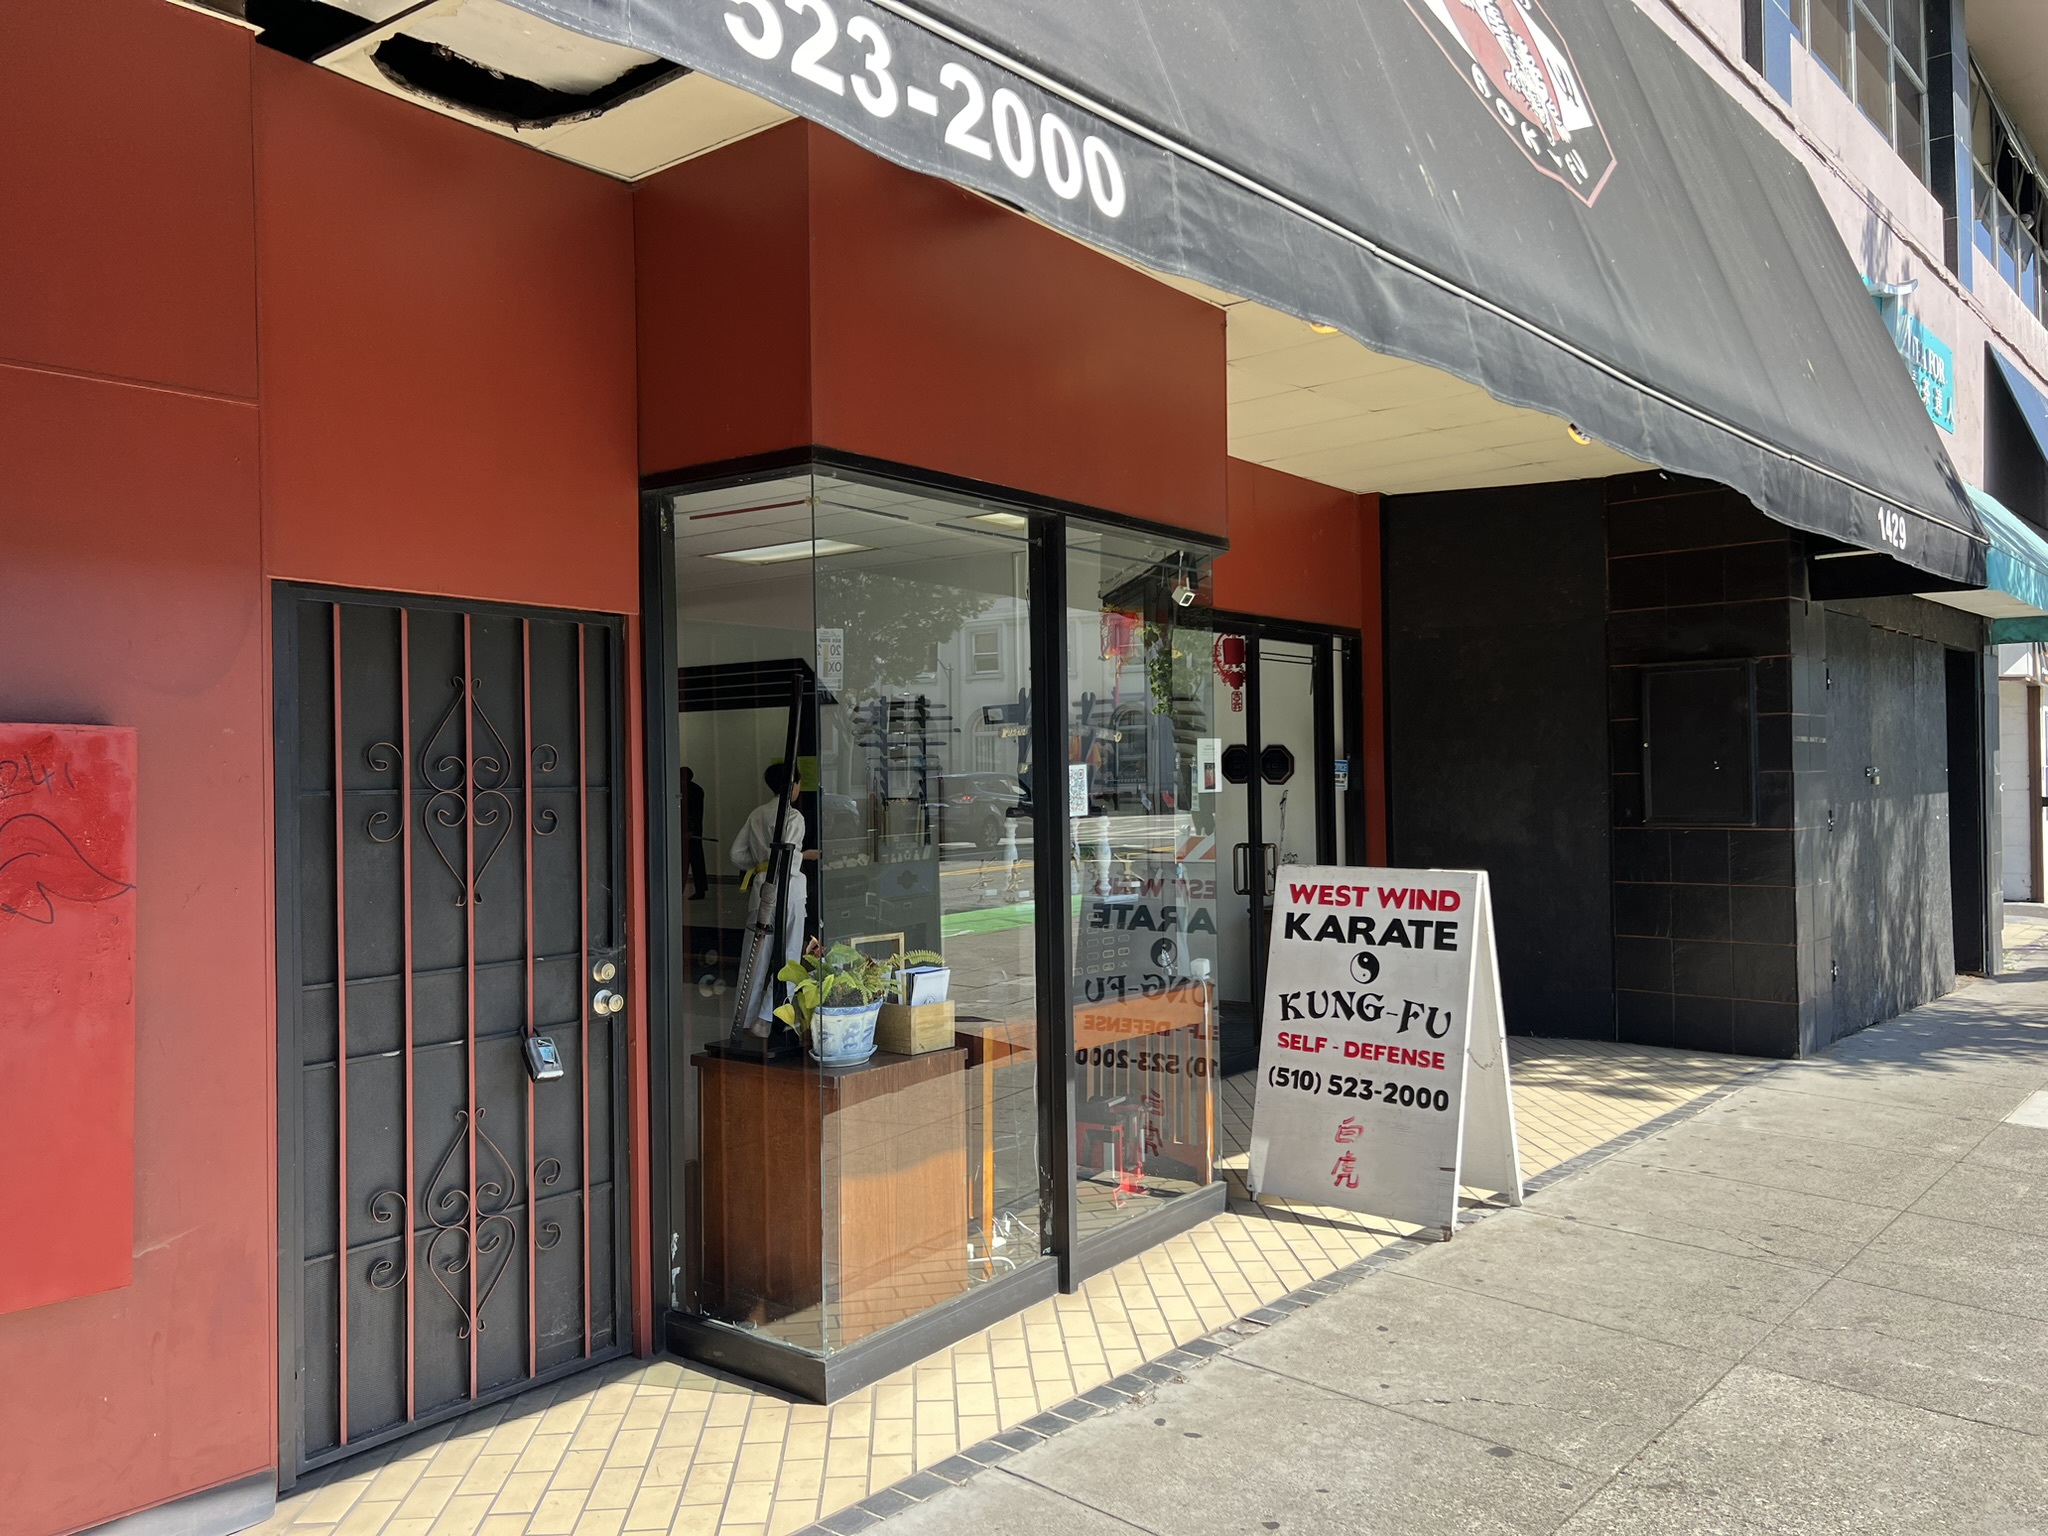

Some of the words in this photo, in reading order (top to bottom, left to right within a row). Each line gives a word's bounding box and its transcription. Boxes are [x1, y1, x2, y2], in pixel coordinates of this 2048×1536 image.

[723, 0, 1127, 219] 523-2000
[1877, 506, 1906, 550] 1429
[1289, 883, 1370, 907] WEST
[1377, 887, 1461, 912] WIND
[1284, 912, 1458, 951] KARATE
[1278, 990, 1452, 1039] KUNG-FU
[1277, 1031, 1328, 1054] SELF
[1343, 1041, 1445, 1070] DEFENSE
[1269, 1066, 1322, 1094] (510)
[1327, 1074, 1450, 1112] 523-2000
[1331, 1116, 1364, 1188] 白虎
